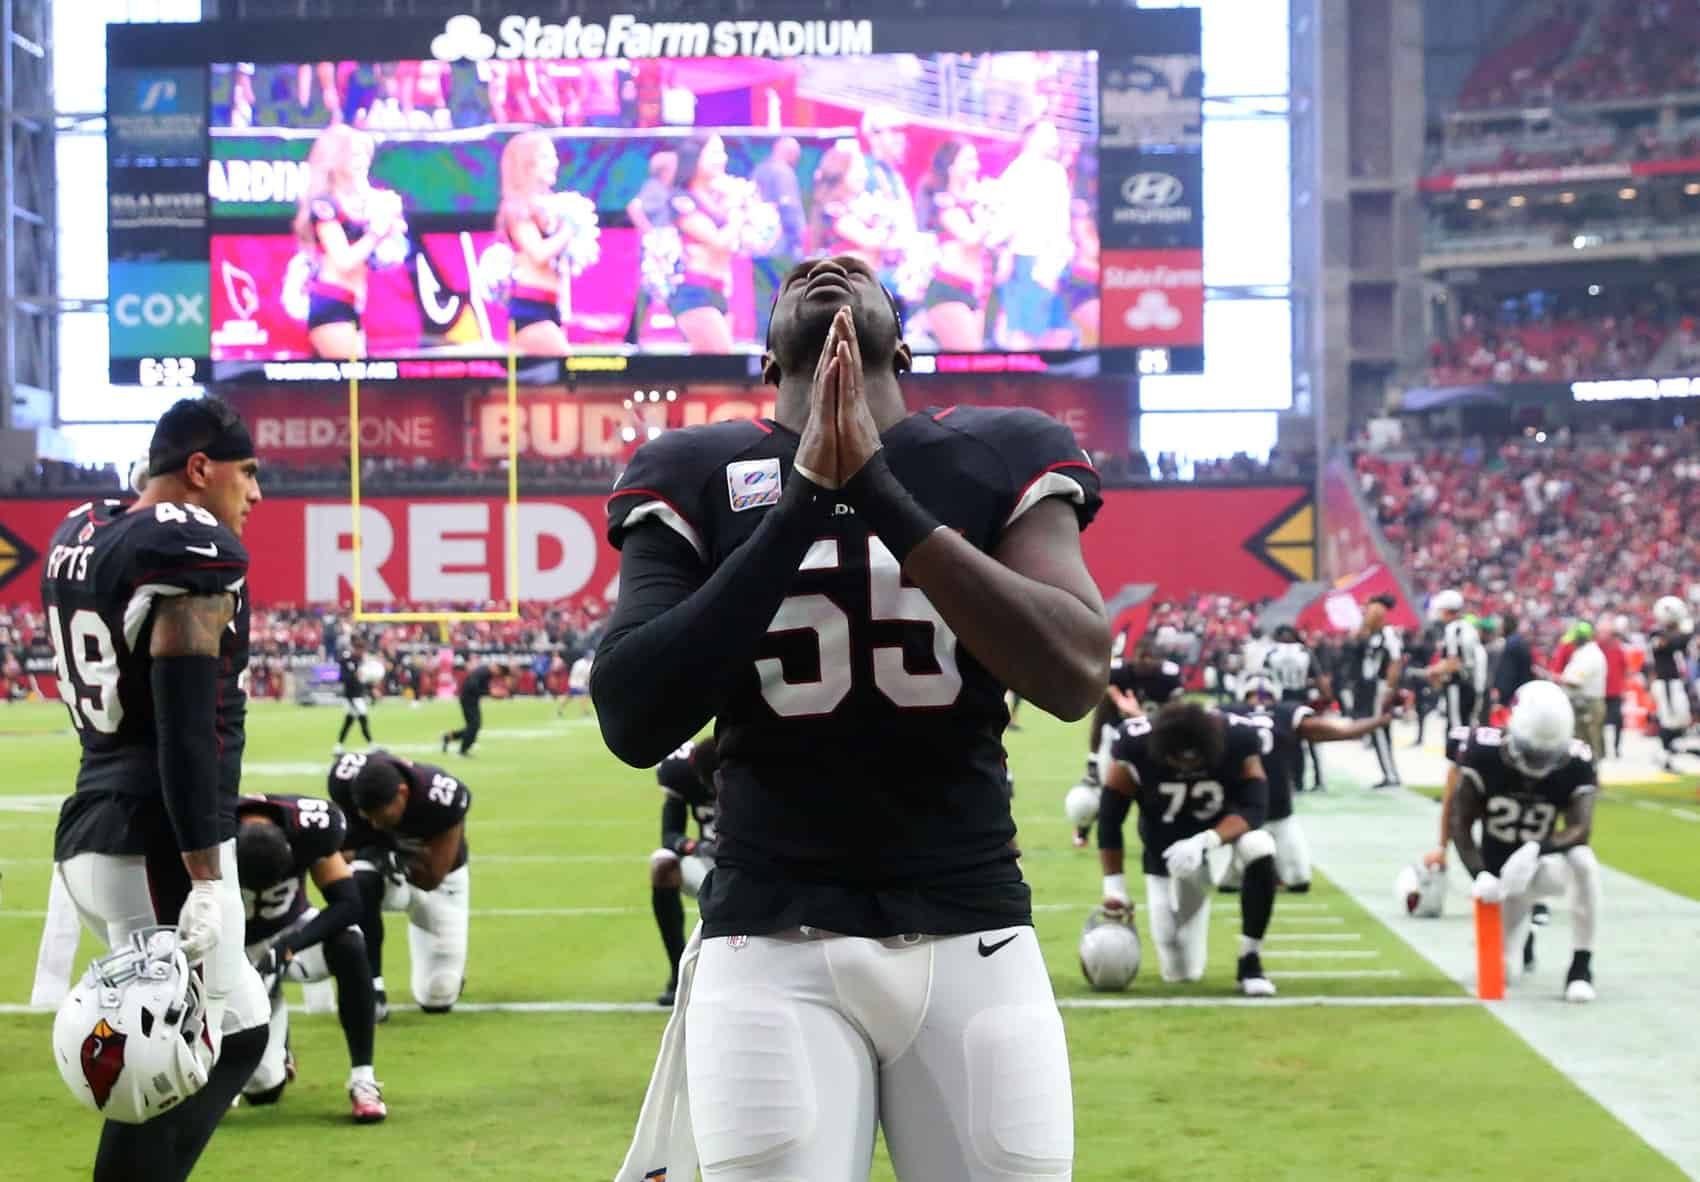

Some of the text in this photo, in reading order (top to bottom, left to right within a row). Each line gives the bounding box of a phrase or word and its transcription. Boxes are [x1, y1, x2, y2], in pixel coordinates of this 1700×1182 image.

[713, 19, 872, 55] STADIUM
[115, 293, 204, 326] COX
[255, 416, 434, 449] REDZONE
[303, 502, 621, 602] RED
[753, 535, 963, 718] 55
[48, 605, 125, 734] 49
[429, 774, 458, 807] 25
[1158, 780, 1225, 822] 73
[298, 798, 330, 829] 39
[1486, 796, 1556, 844] 29
